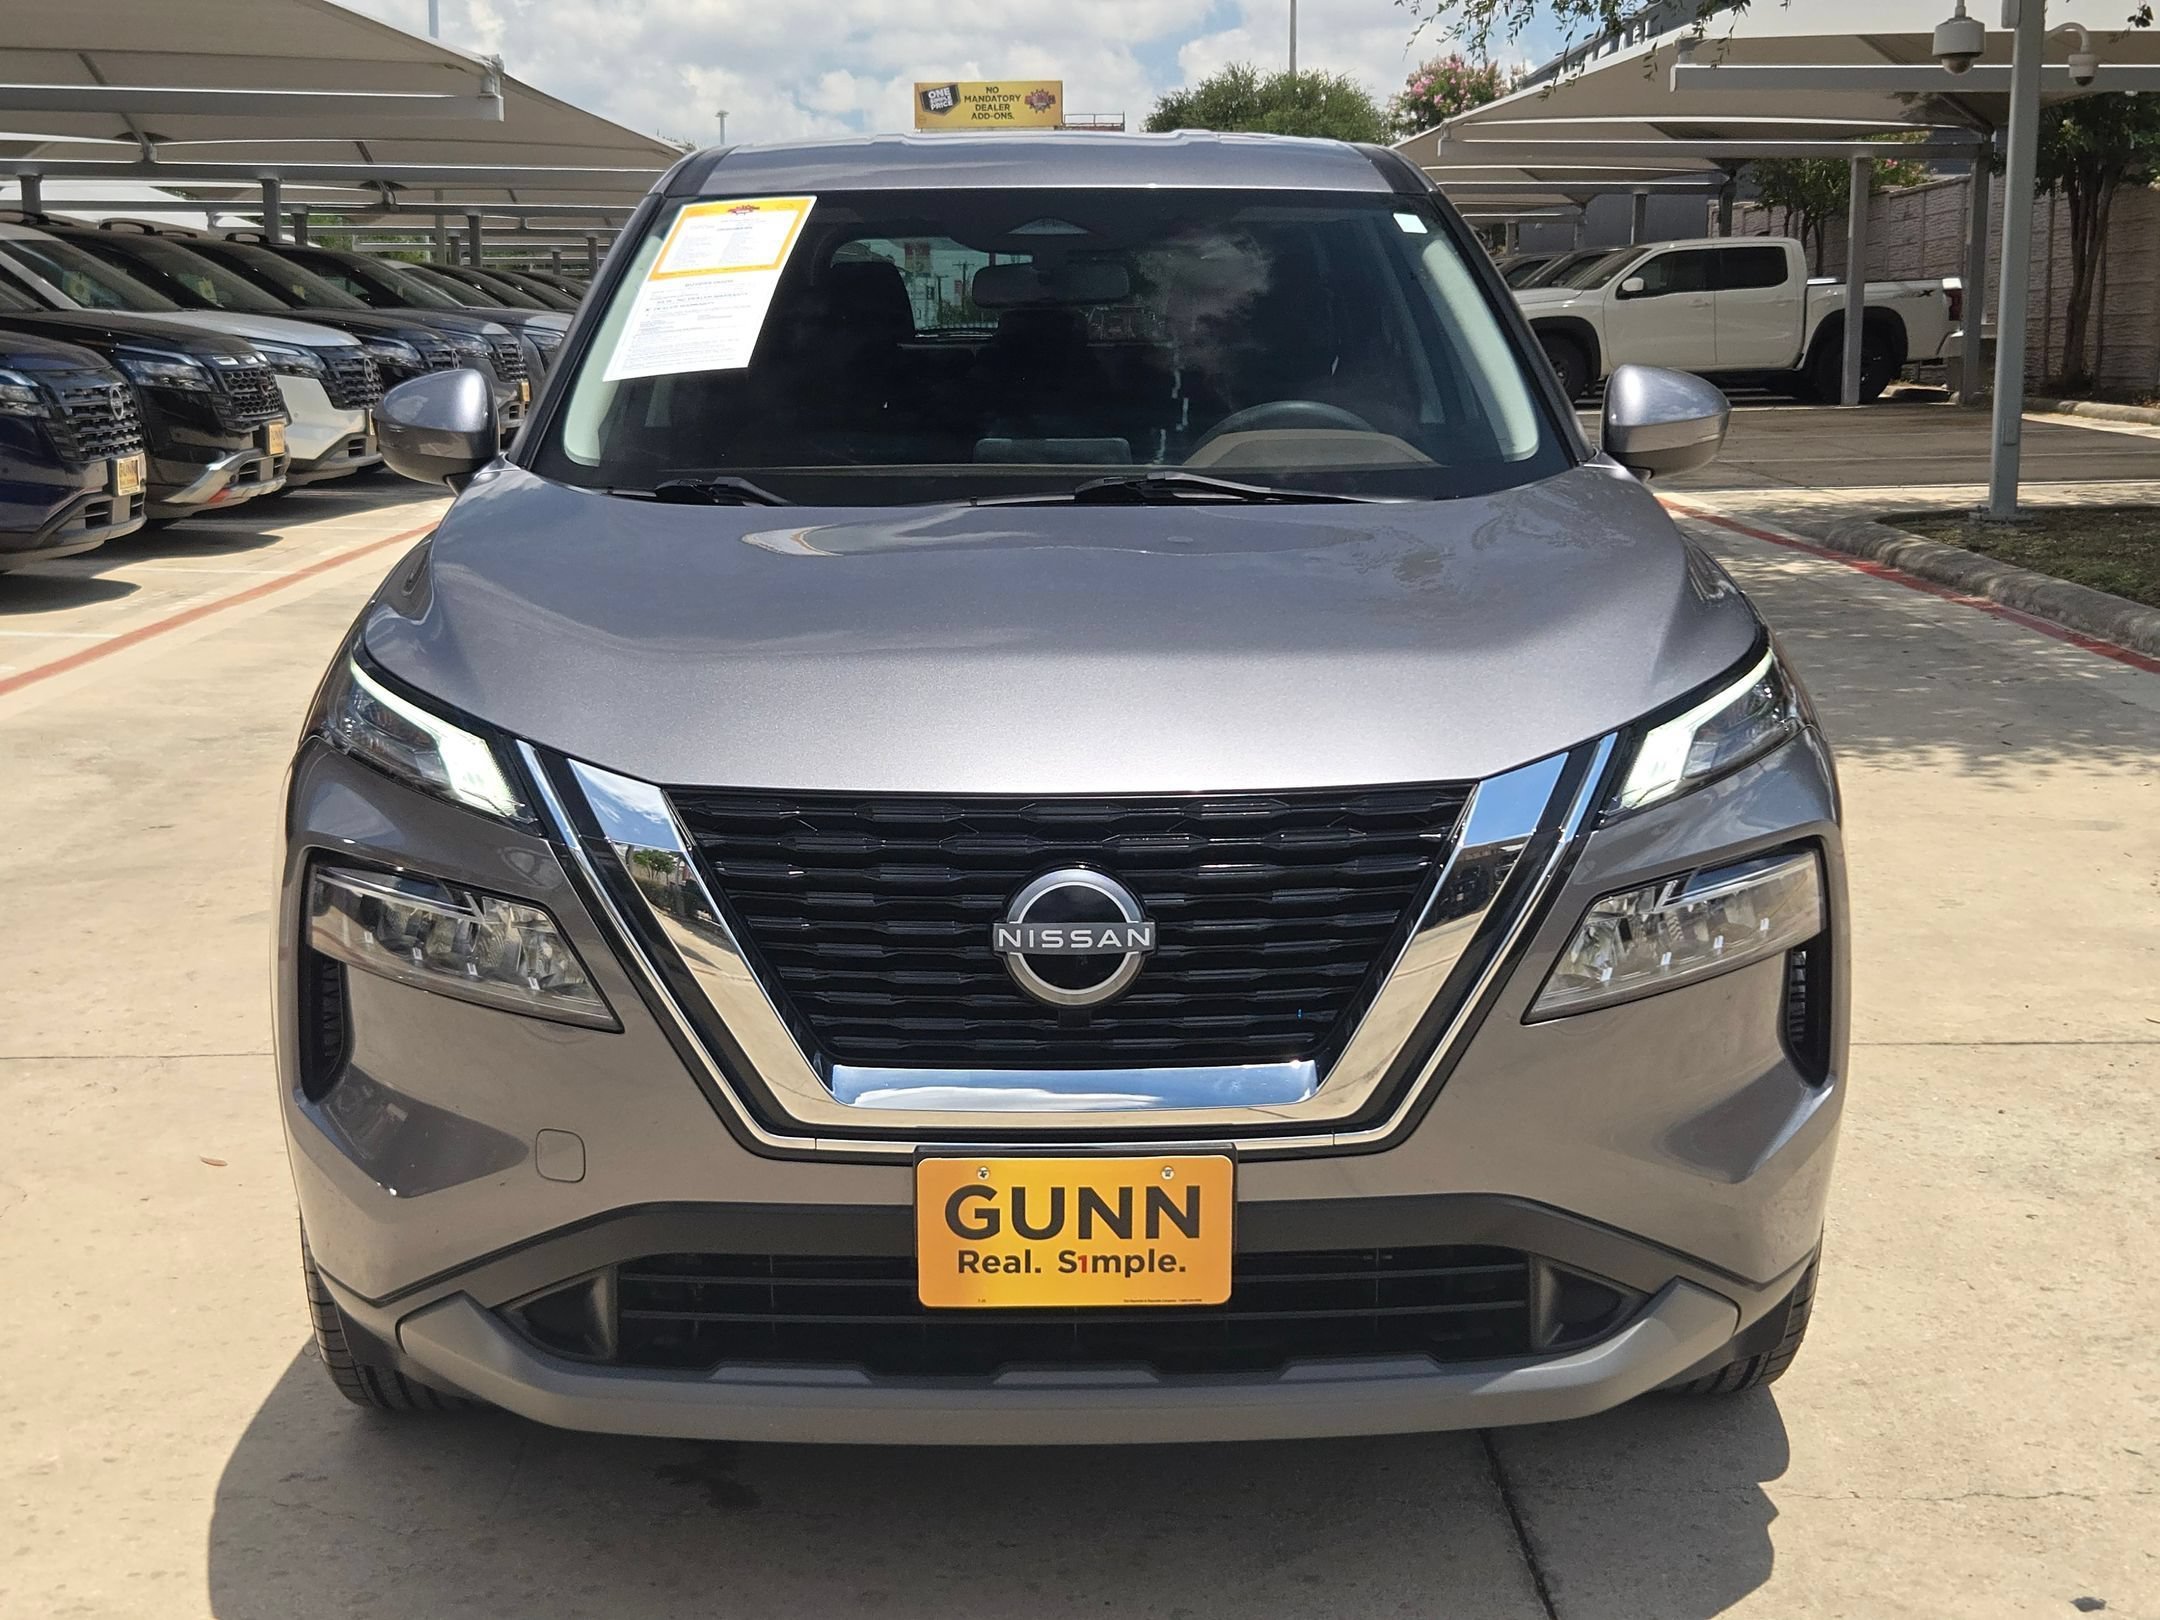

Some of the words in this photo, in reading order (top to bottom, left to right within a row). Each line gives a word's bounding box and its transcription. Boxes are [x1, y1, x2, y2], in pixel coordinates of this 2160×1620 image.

[928, 87, 950, 99] ONE
[985, 86, 1000, 94] NO
[964, 95, 1021, 103] MANDATORY
[930, 101, 953, 111] PRICE
[975, 103, 1010, 111] DEALER
[971, 112, 1015, 120] ADD-ONS.
[998, 928, 1150, 948] NISSAN
[944, 1184, 1201, 1241] GUNN
[958, 1249, 1042, 1274] Real.
[1058, 1248, 1186, 1278] S1mple.
